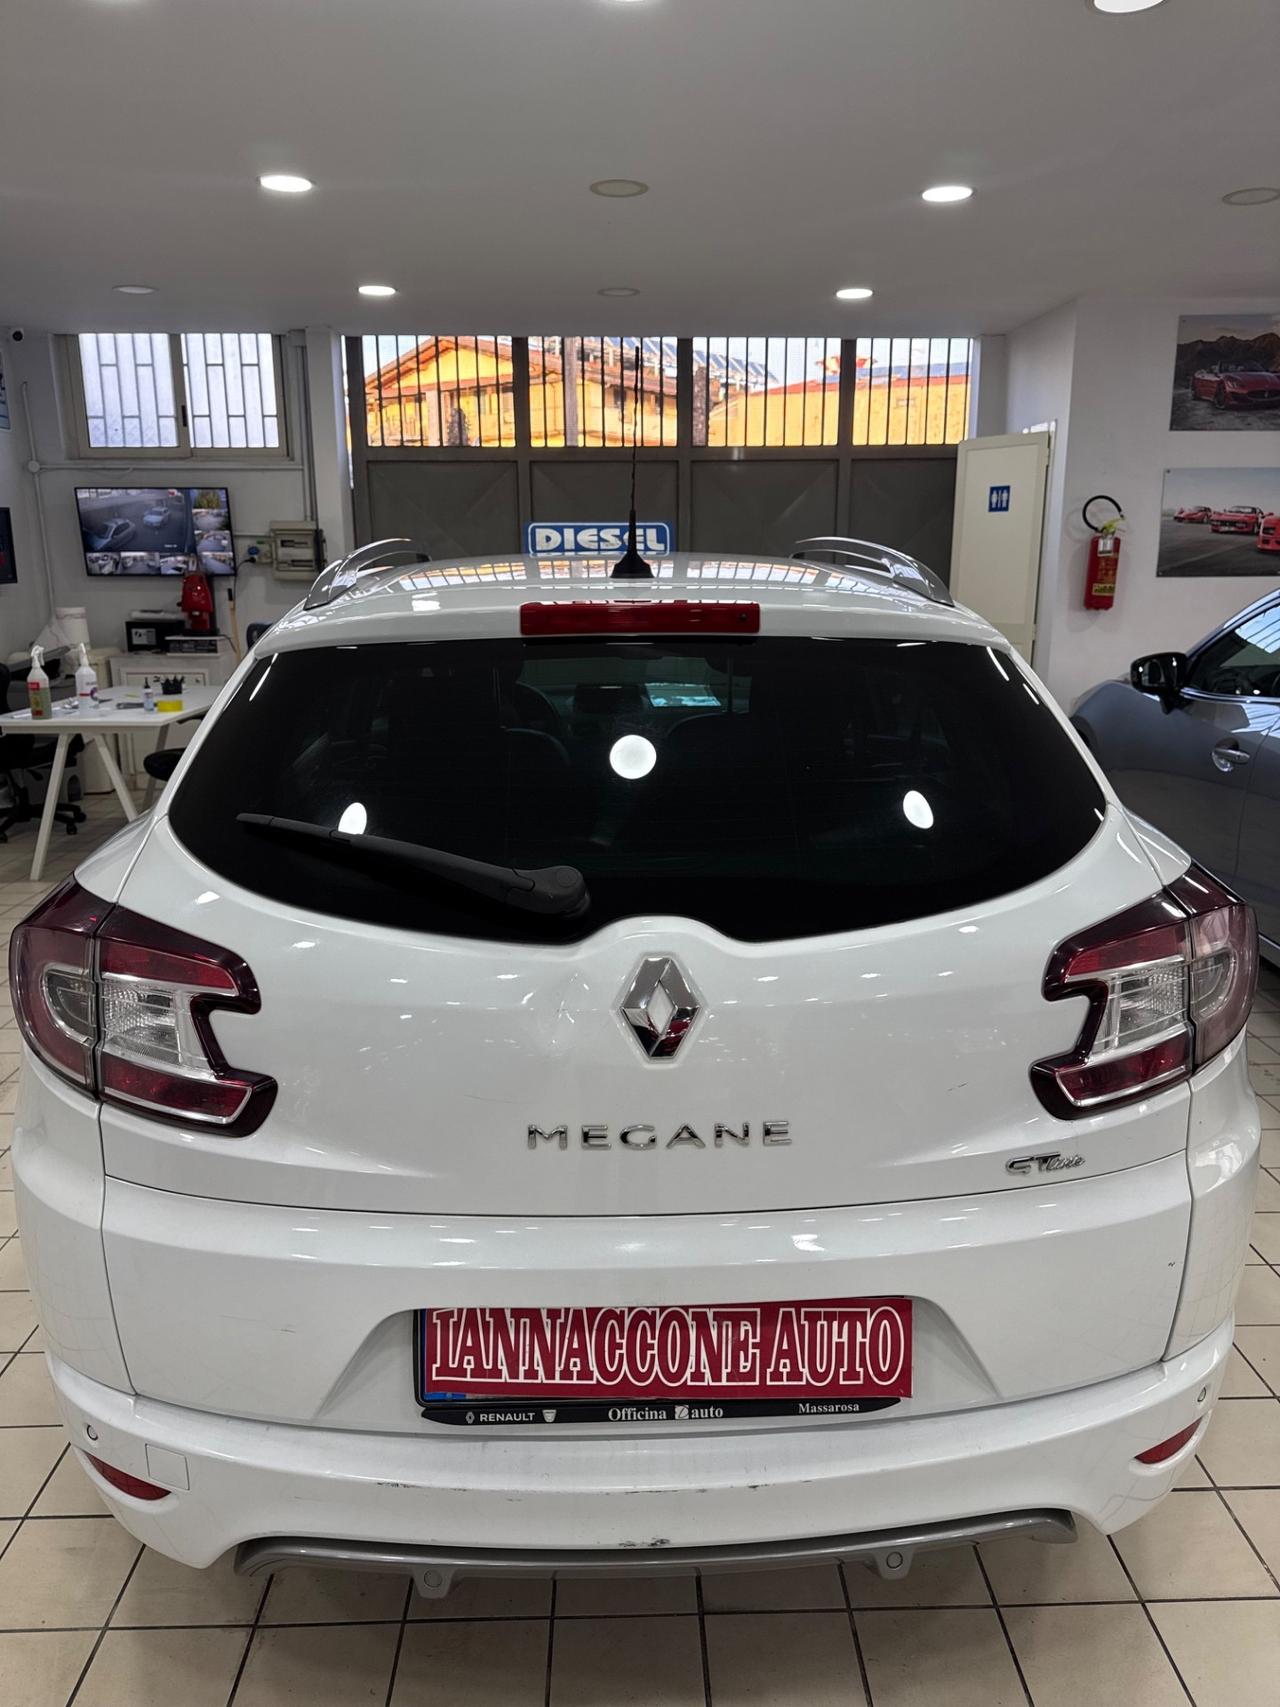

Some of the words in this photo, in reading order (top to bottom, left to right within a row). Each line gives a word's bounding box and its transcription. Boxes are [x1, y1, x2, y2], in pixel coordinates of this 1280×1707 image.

[535, 528, 665, 551] DIESEL
[527, 1120, 792, 1150] MEGANE
[432, 1307, 760, 1386] IANNACCONE
[767, 1305, 904, 1386] AUTO
[479, 1412, 535, 1422] RENAULT
[608, 1407, 667, 1421] Officina
[798, 1402, 860, 1414] Massarosa
